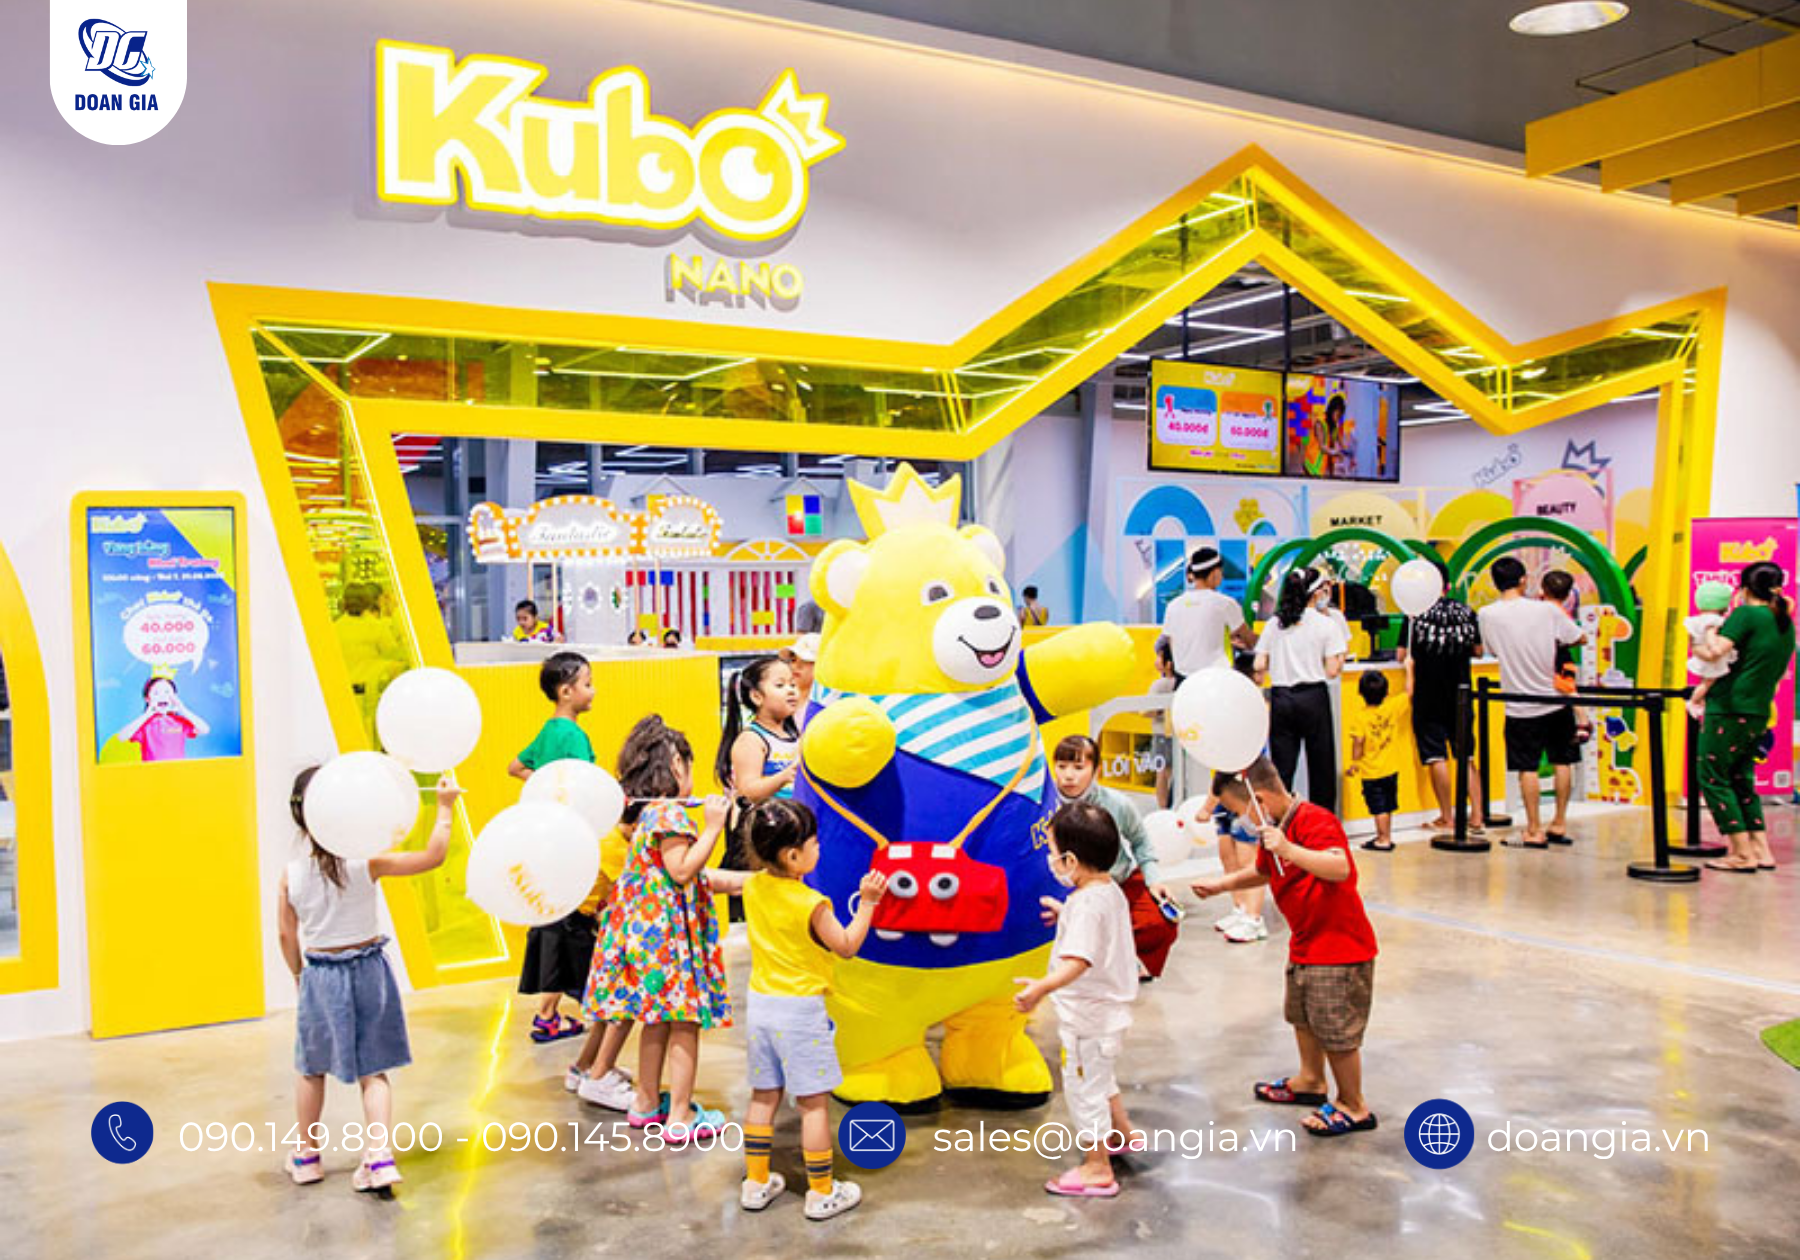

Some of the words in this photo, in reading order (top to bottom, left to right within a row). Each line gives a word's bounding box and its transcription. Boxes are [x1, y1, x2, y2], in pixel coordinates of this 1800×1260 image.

[670, 252, 803, 299] NANO
[1536, 502, 1577, 516] BEAUTY
[1329, 514, 1383, 527] MARKET
[140, 621, 194, 634] 40.000
[141, 642, 195, 655] 60.000
